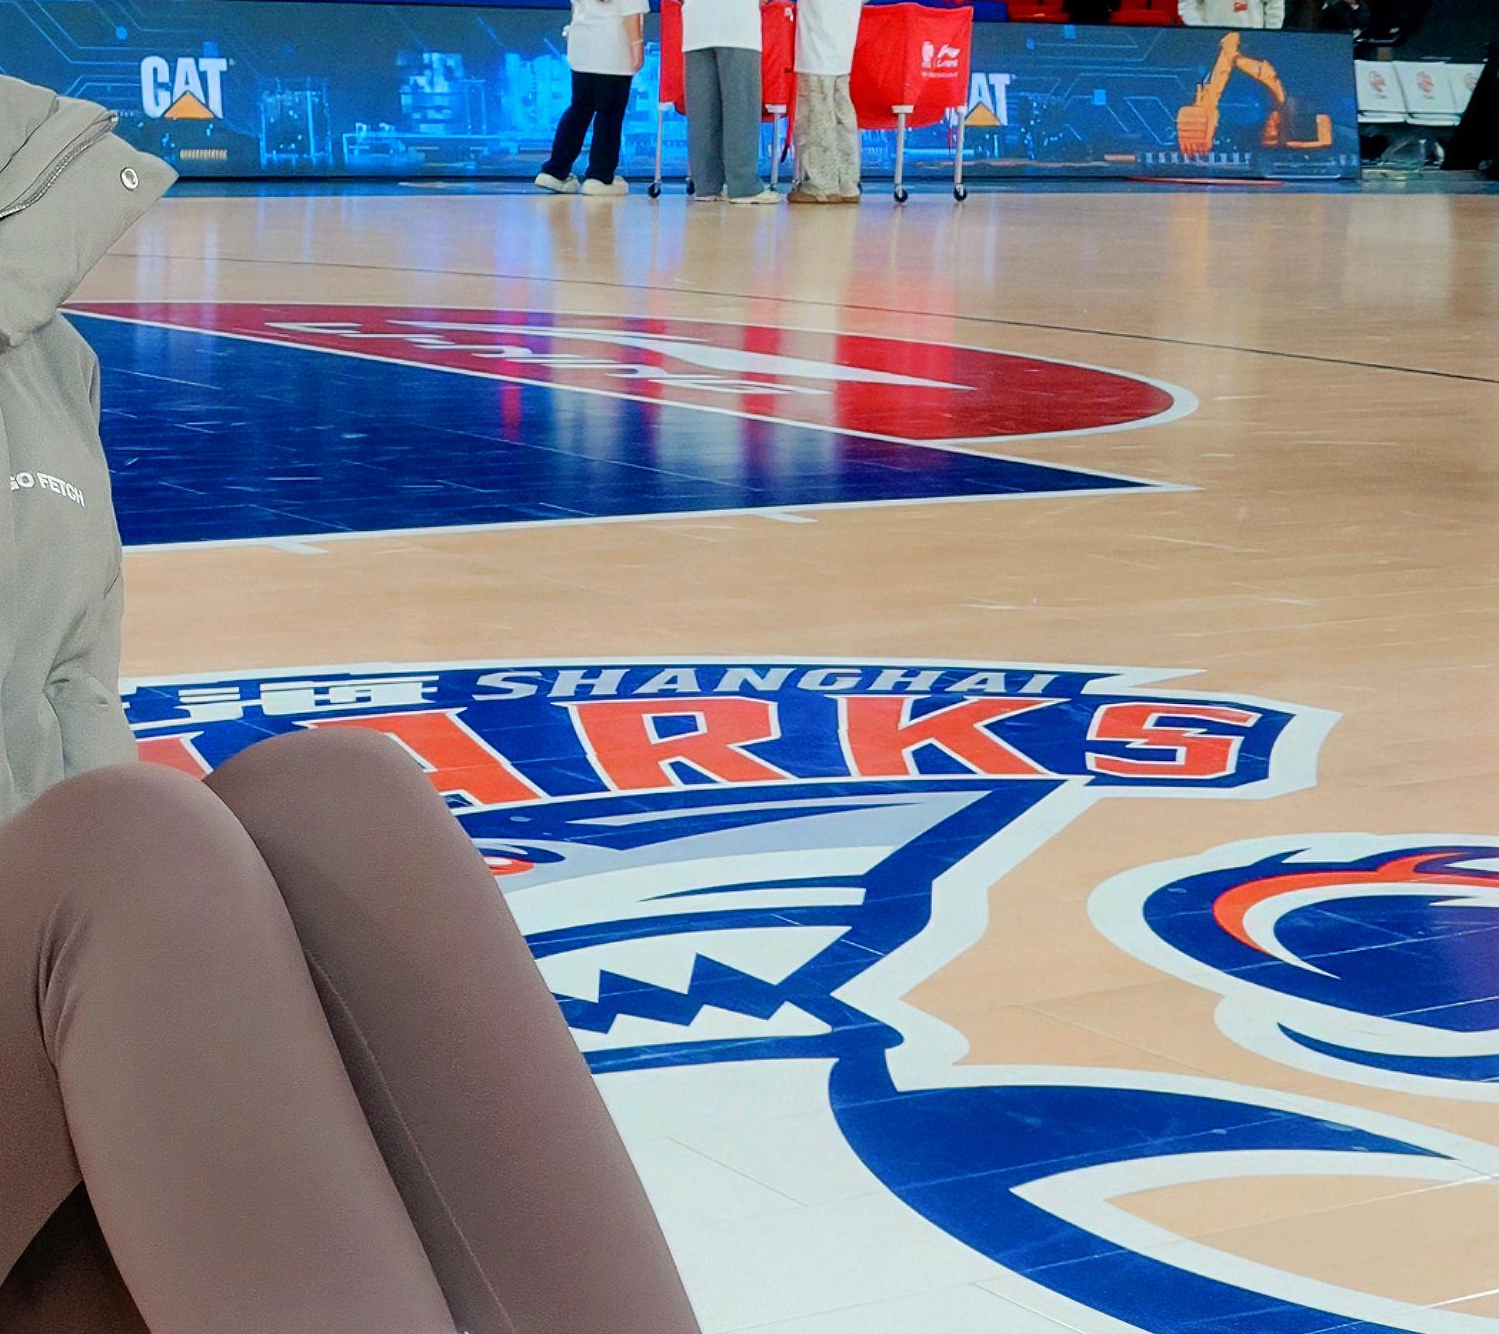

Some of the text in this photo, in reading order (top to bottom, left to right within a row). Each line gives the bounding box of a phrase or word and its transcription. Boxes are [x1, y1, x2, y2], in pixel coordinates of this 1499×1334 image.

[141, 56, 228, 119] CAT
[37, 472, 85, 507] FETCH
[472, 667, 1059, 699] SHANGHAI
